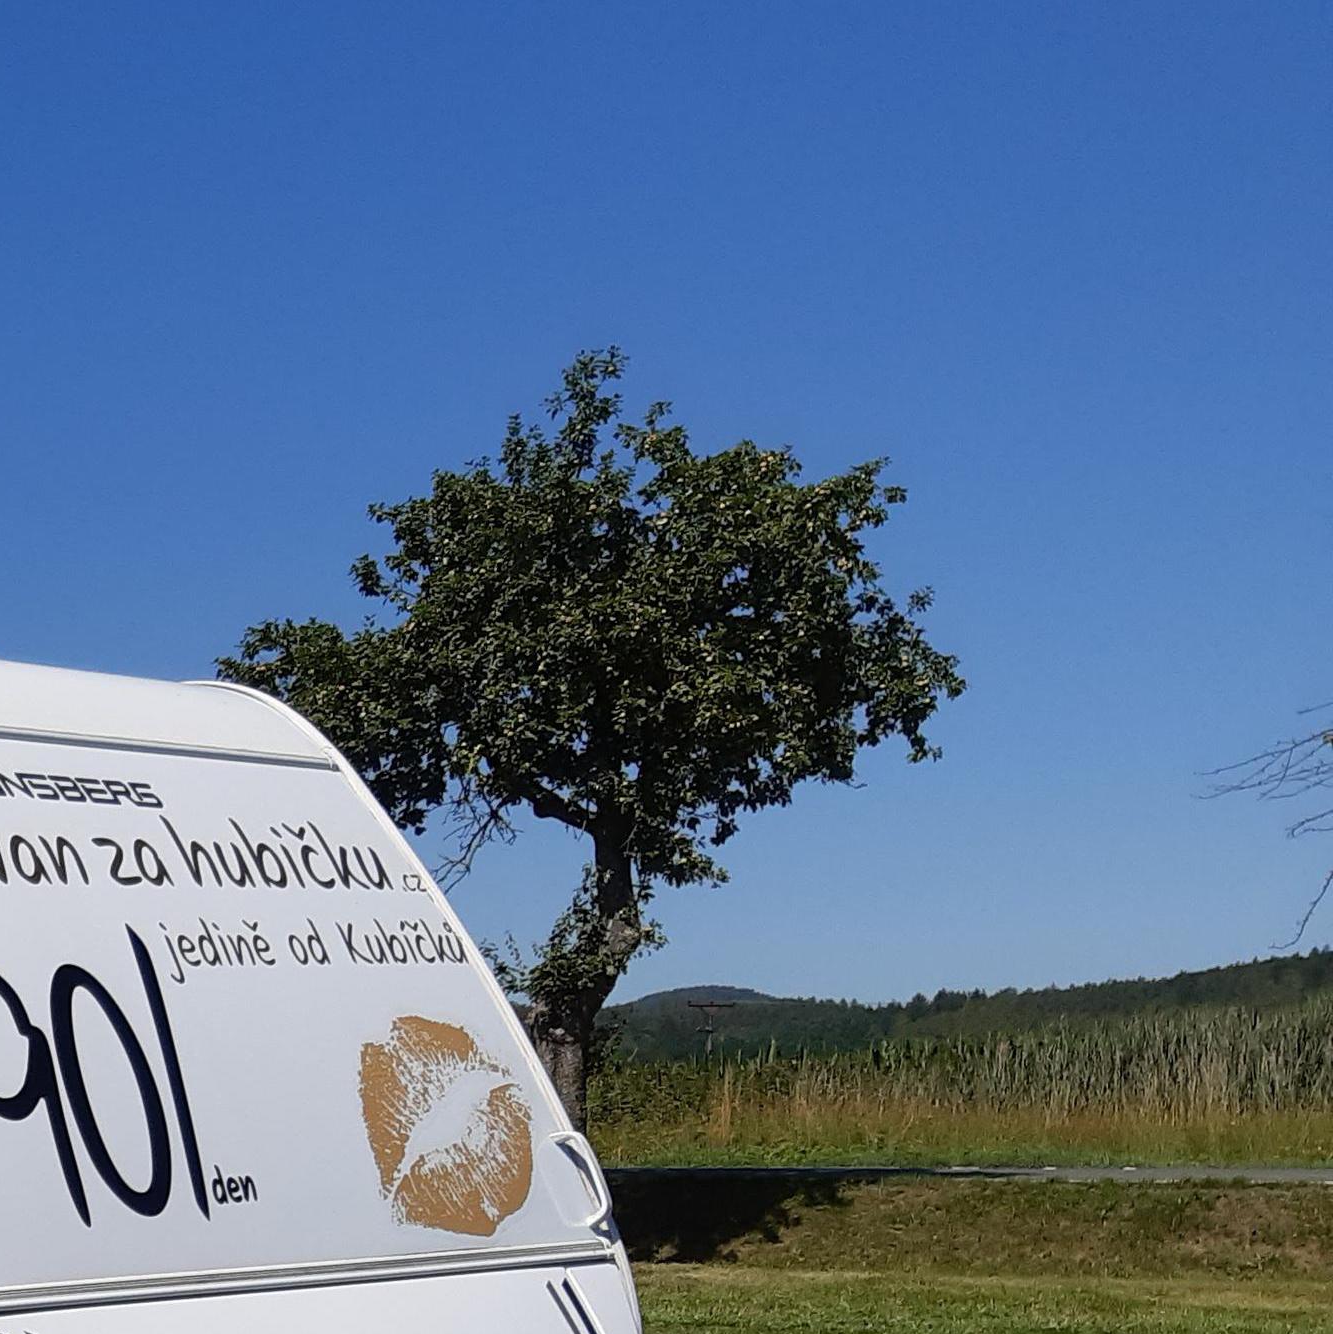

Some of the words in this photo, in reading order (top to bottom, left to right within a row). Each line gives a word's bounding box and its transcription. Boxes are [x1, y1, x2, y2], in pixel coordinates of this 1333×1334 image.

[91, 836, 175, 887] za
[159, 814, 394, 890] hubičku
[158, 916, 277, 984] jedině
[288, 917, 332, 965] od
[211, 1165, 258, 1204] den
